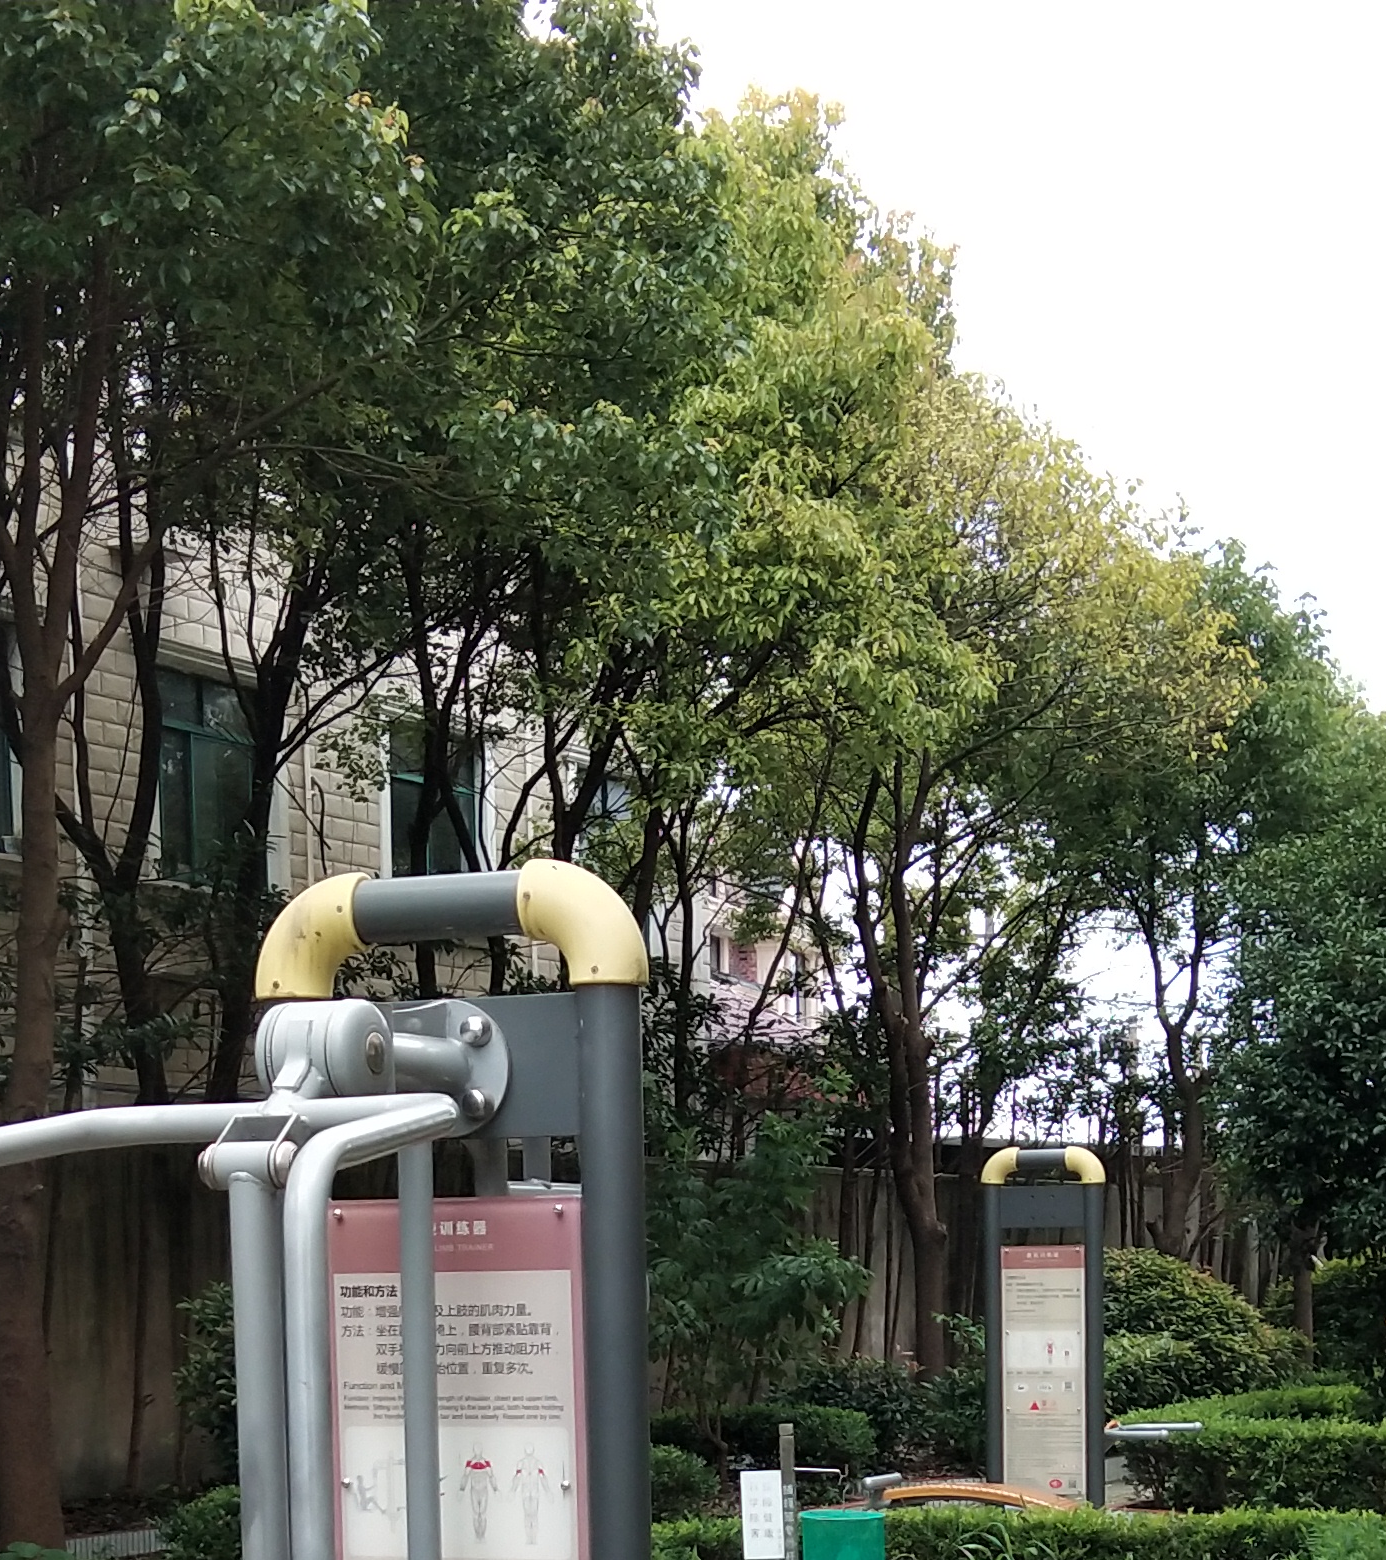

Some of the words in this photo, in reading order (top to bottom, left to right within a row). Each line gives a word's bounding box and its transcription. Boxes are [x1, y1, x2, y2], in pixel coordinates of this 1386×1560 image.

[433, 1220, 487, 1236] 训练器
[340, 1285, 398, 1299] 功能和方法
[341, 1304, 402, 1318] 功能：增强
[341, 1324, 402, 1338] 方法：坐在
